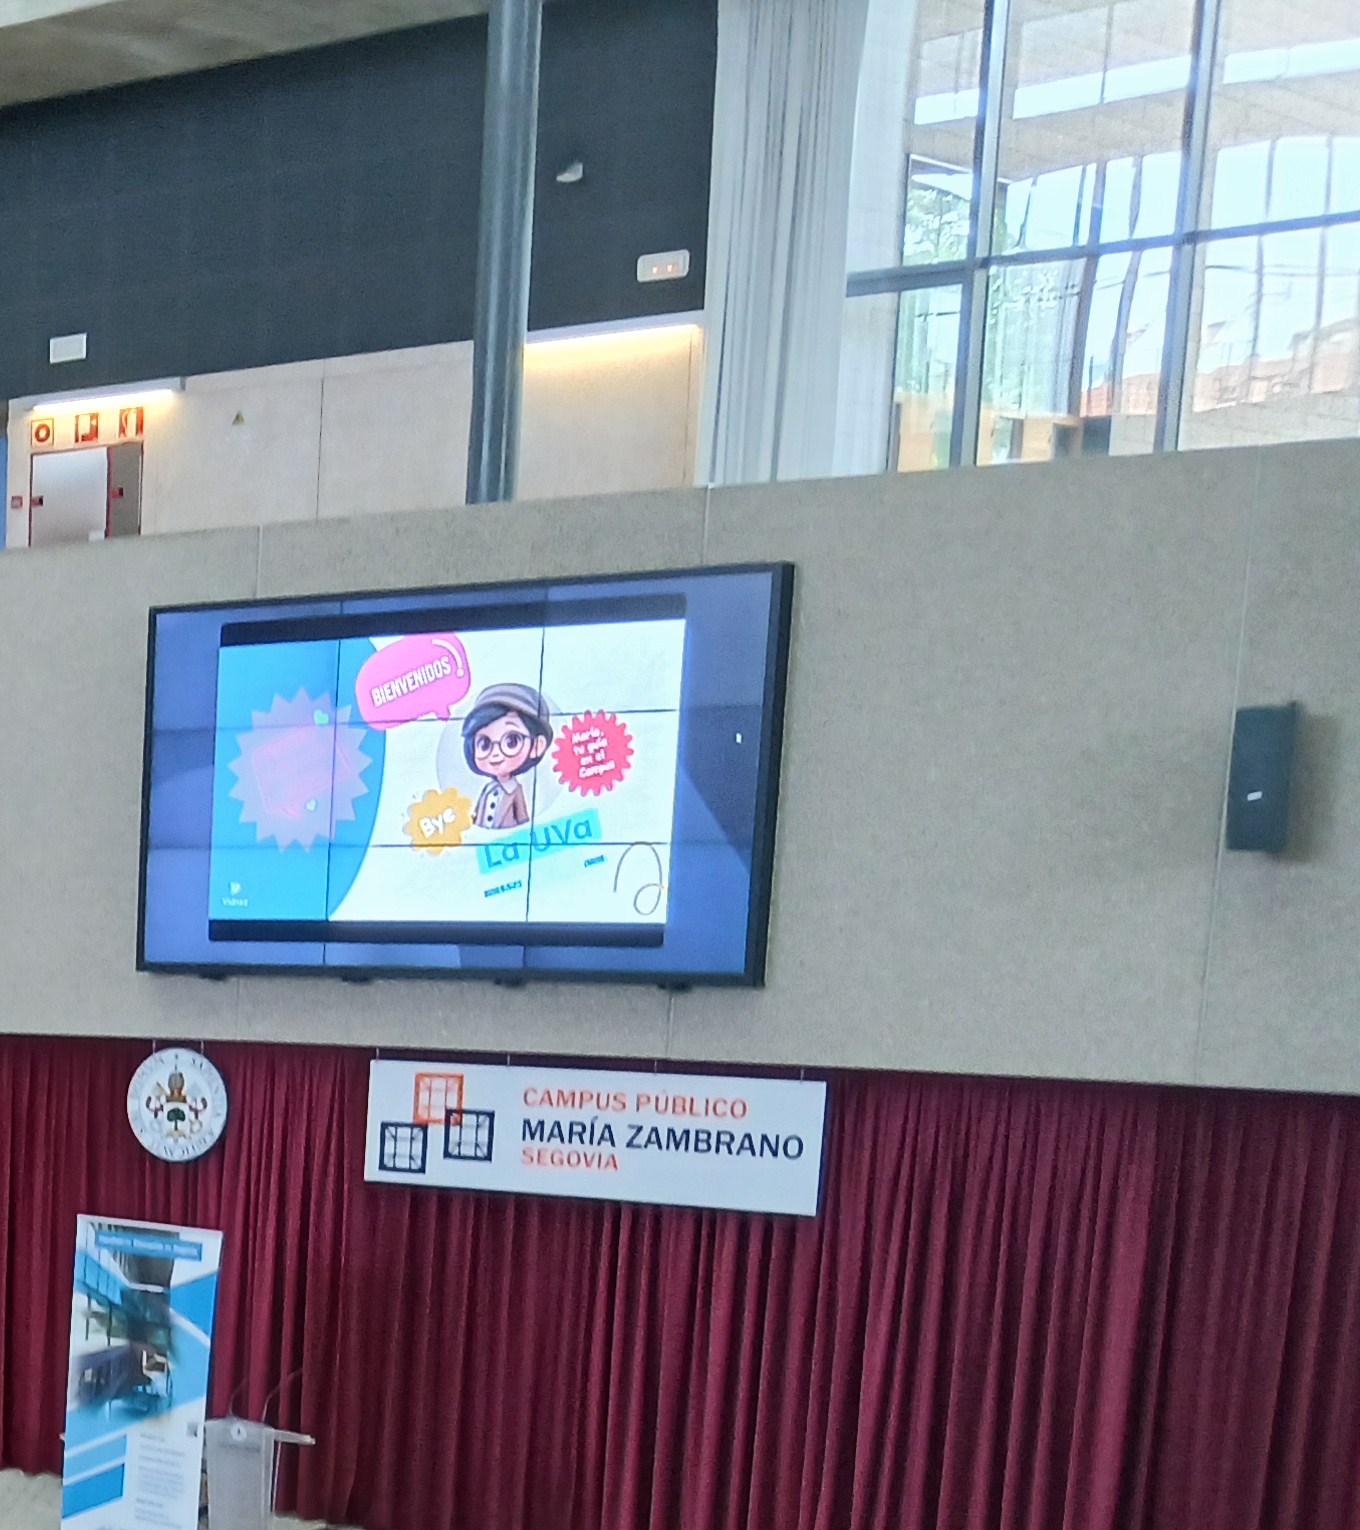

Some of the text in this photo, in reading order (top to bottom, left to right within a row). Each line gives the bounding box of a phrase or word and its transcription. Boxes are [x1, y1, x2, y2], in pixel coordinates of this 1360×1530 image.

[418, 807, 456, 839] Bye
[483, 818, 593, 869] La UVa
[523, 1087, 748, 1119] CAMPUS PÚBLICO
[521, 1115, 804, 1160] MARÍA ZAMBRANO
[521, 1145, 619, 1171] SEGOVIA
